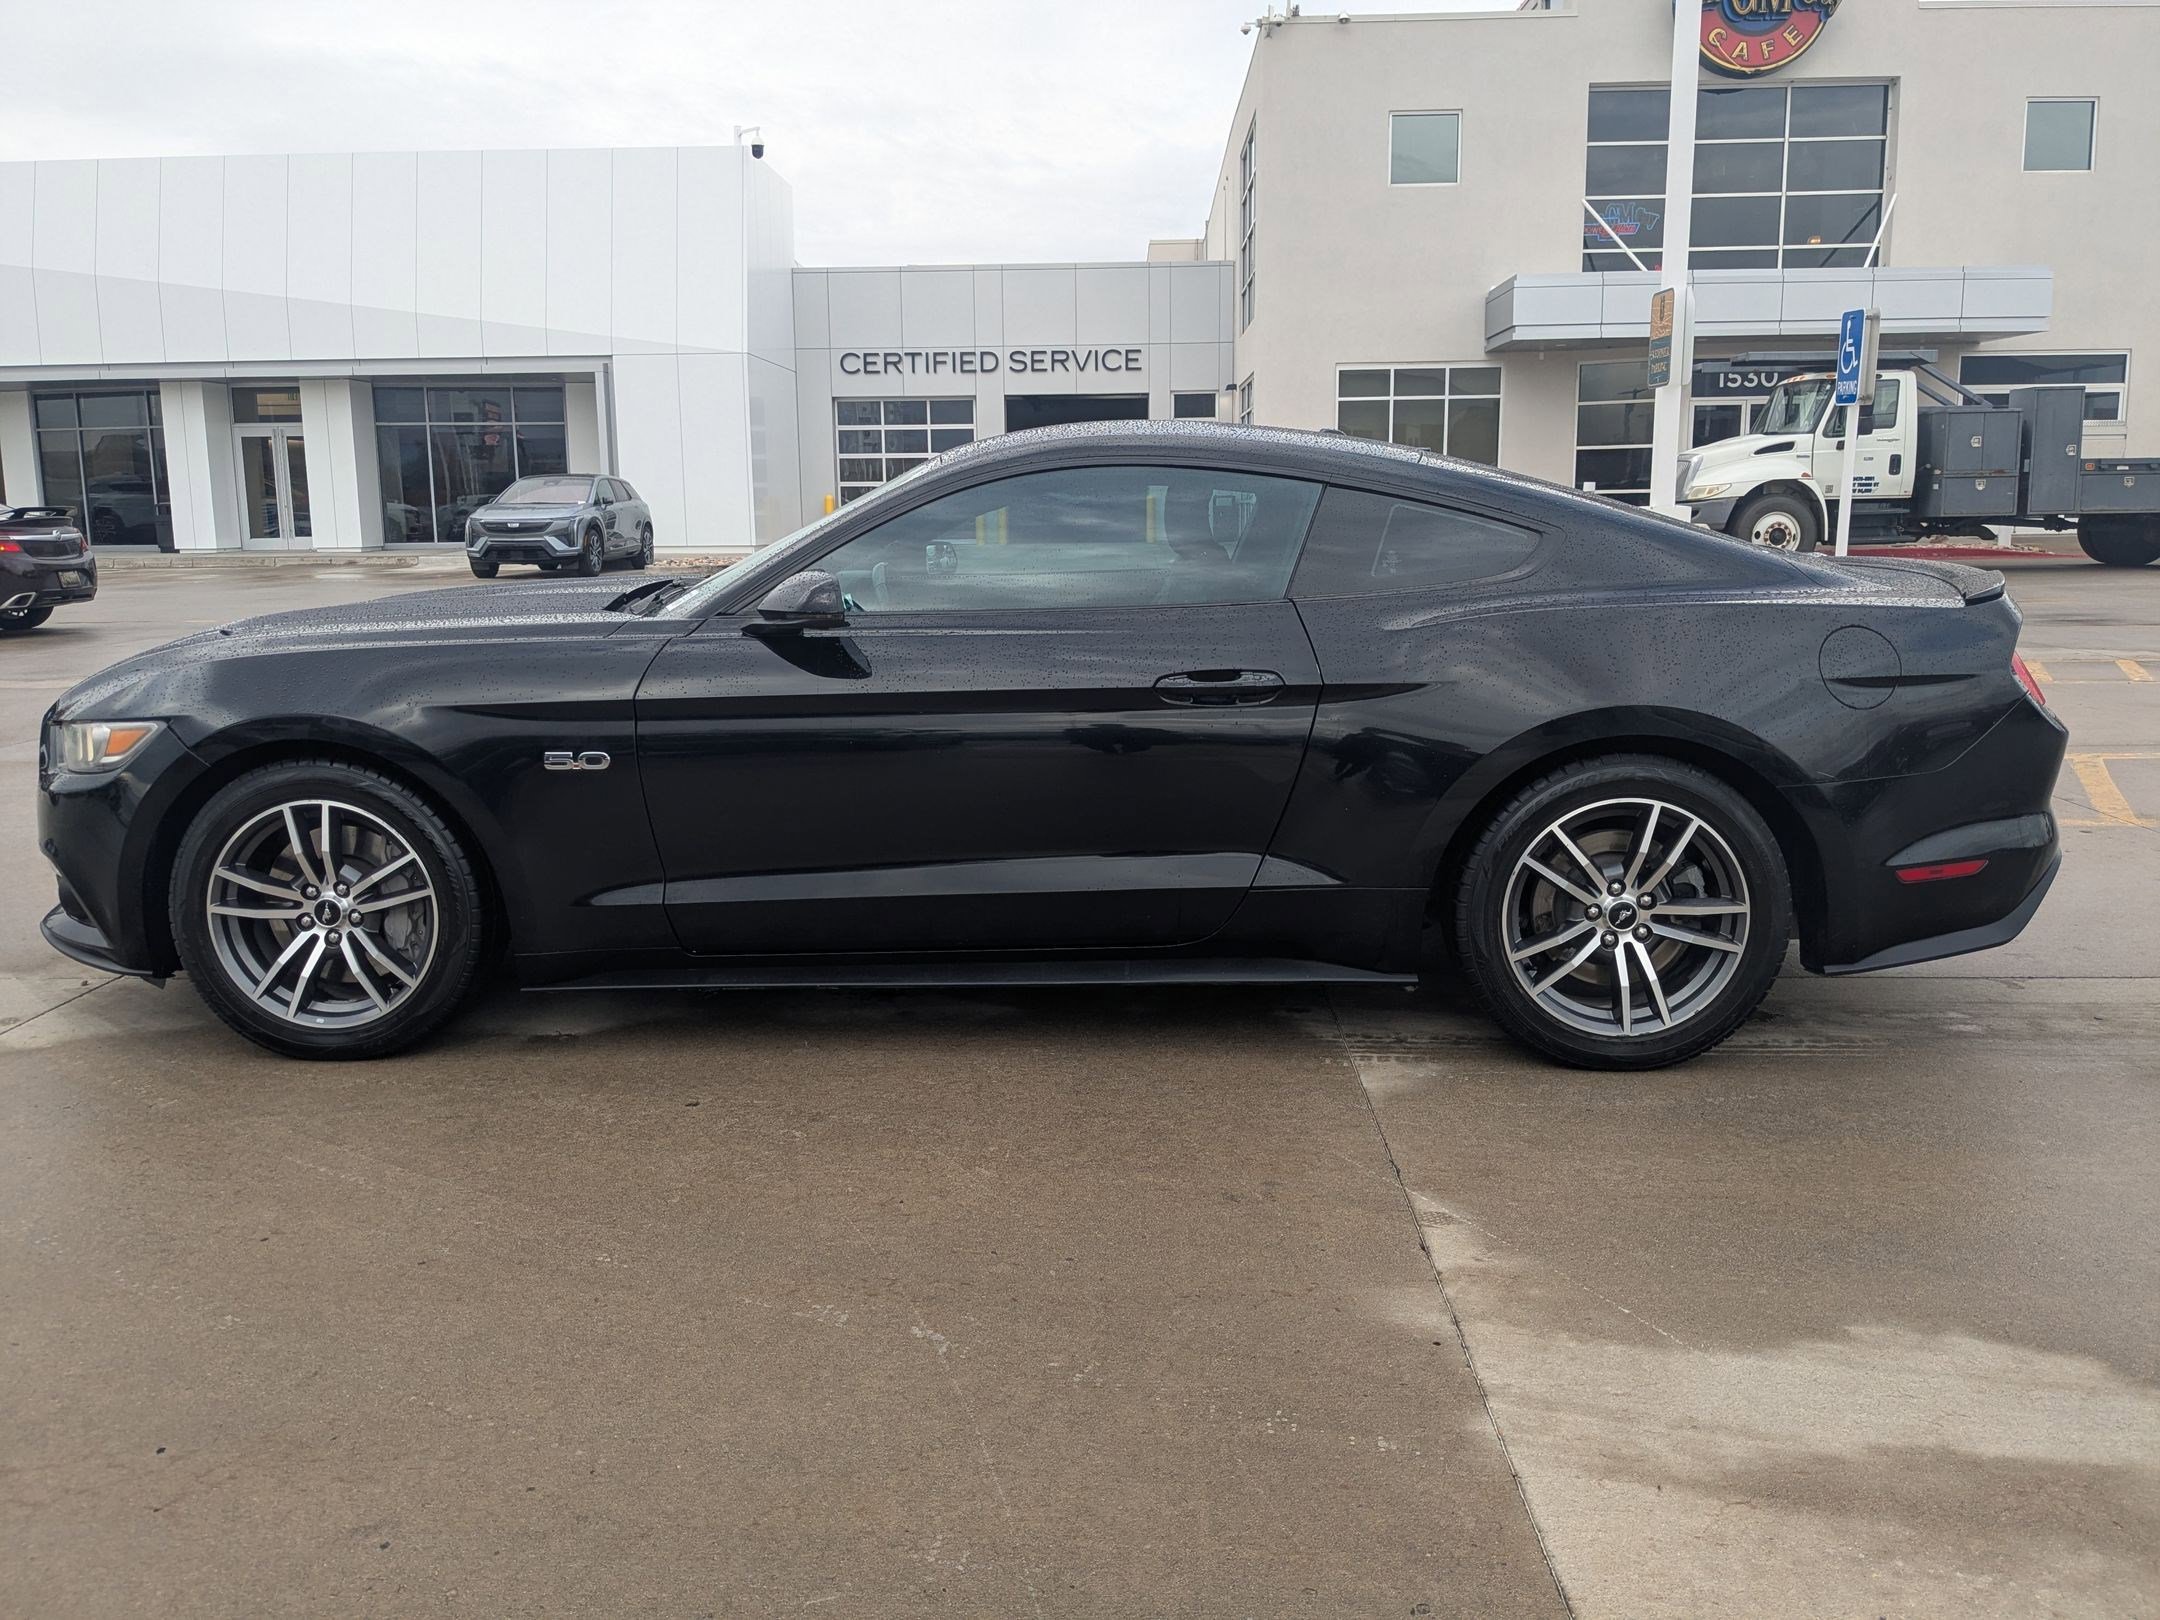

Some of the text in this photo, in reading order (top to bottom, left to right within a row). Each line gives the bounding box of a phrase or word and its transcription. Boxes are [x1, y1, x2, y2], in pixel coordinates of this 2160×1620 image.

[1708, 25, 1804, 62] CAFE
[840, 349, 1143, 375] CERTIFIED SERVICE
[1719, 372, 1779, 388] 1530
[1837, 380, 1858, 396] PARKING
[544, 751, 611, 770] 5.0
